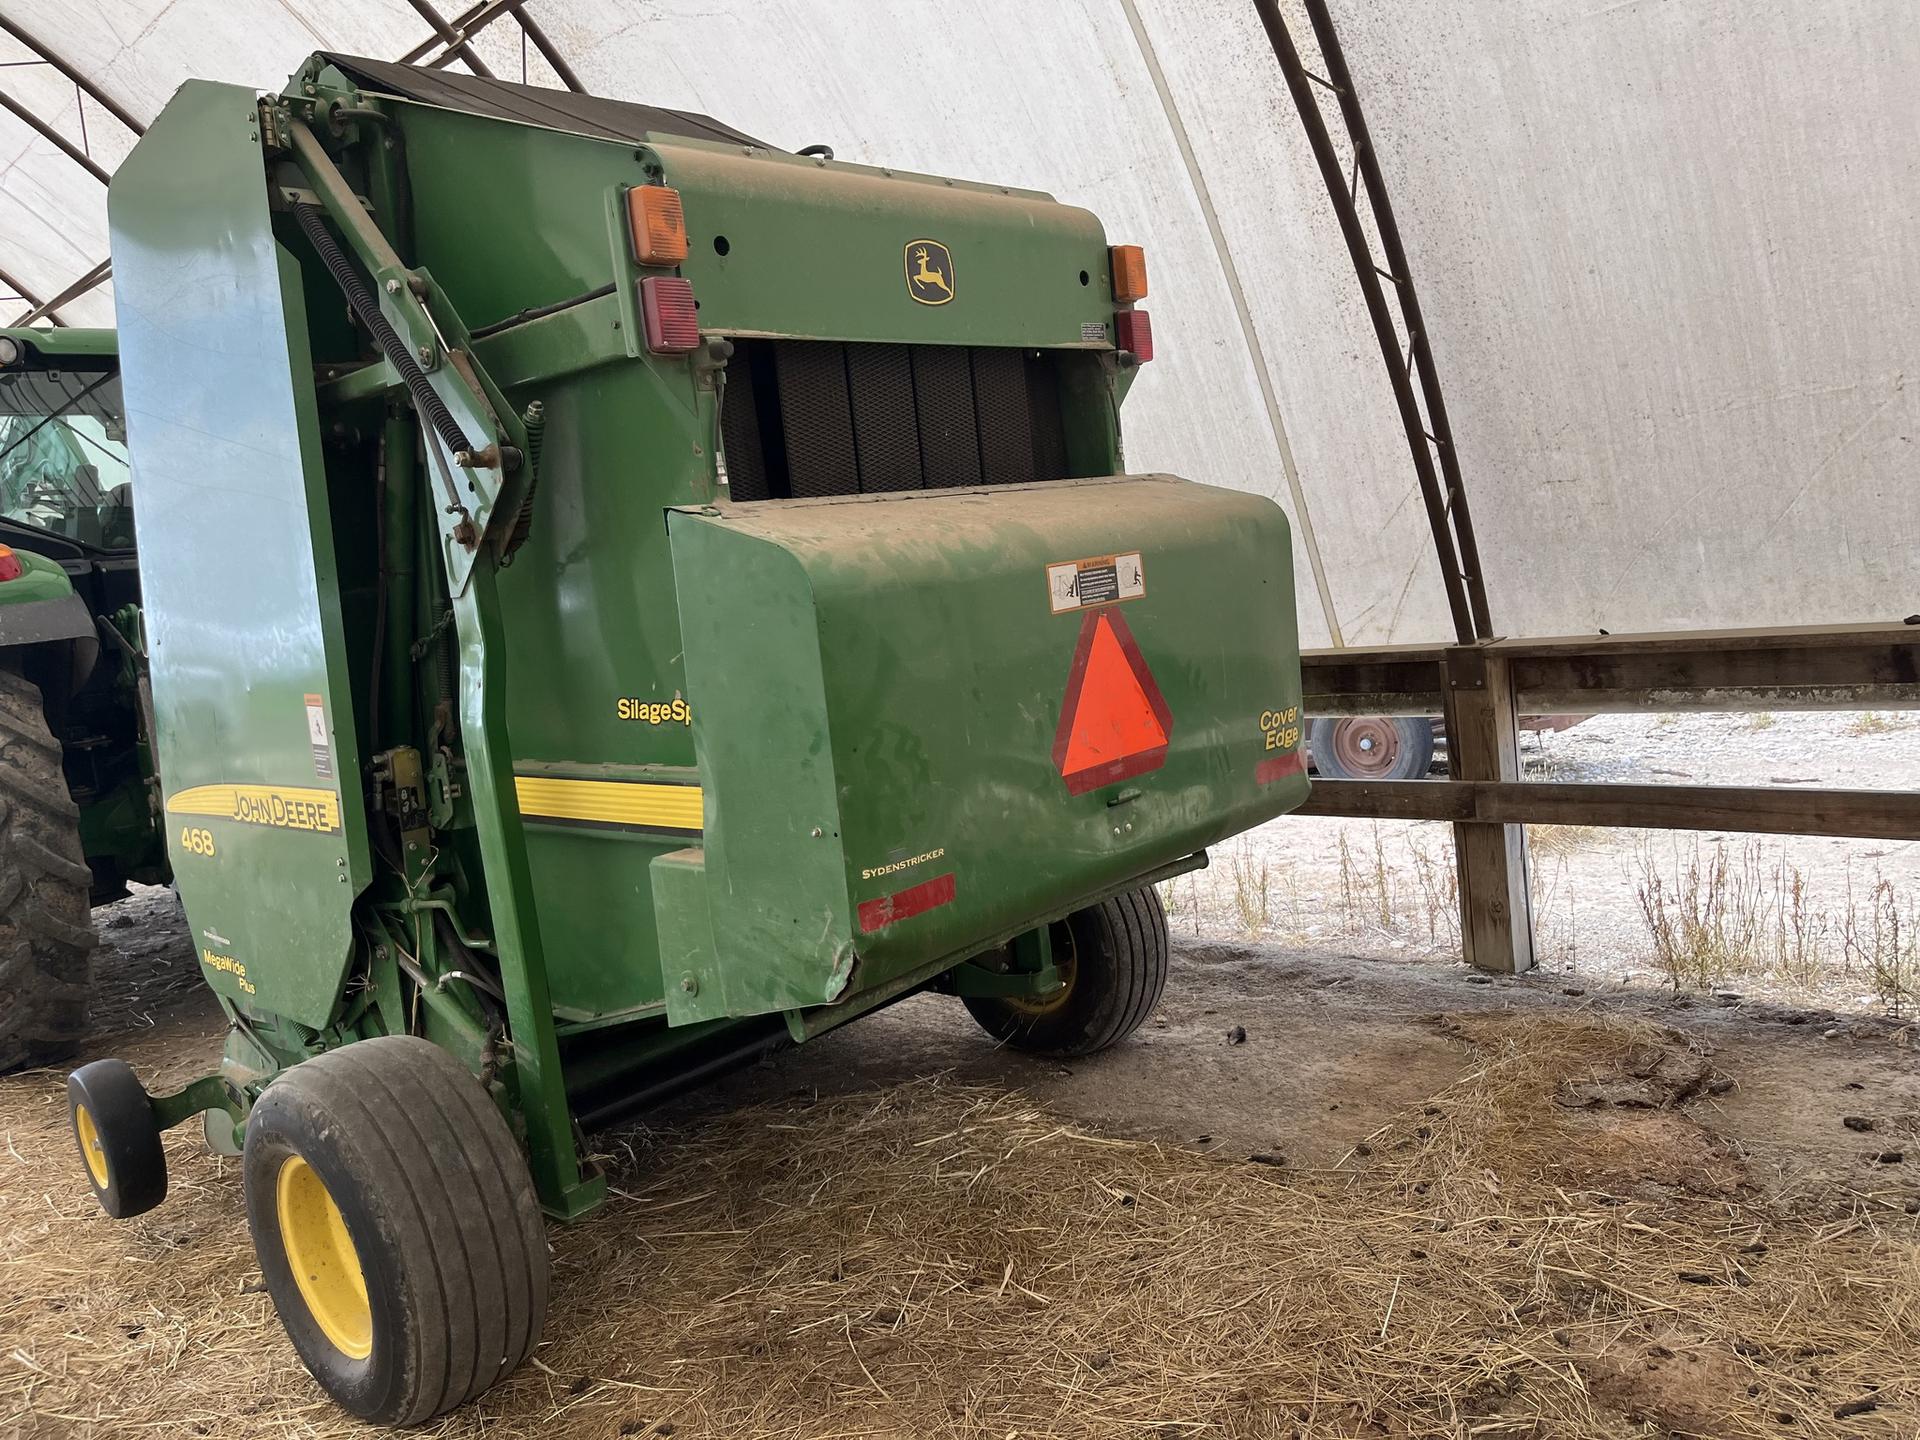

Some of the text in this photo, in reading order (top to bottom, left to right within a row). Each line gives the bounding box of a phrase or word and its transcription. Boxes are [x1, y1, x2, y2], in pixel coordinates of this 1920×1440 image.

[1260, 704, 1298, 731] Cover
[1265, 726, 1299, 751] Edge
[233, 790, 331, 830] JOHN DEERE
[181, 826, 215, 856] 468
[862, 848, 945, 880] SYDENSTRICKER
[203, 949, 246, 977] MegaWide
[238, 977, 256, 995] Plus
